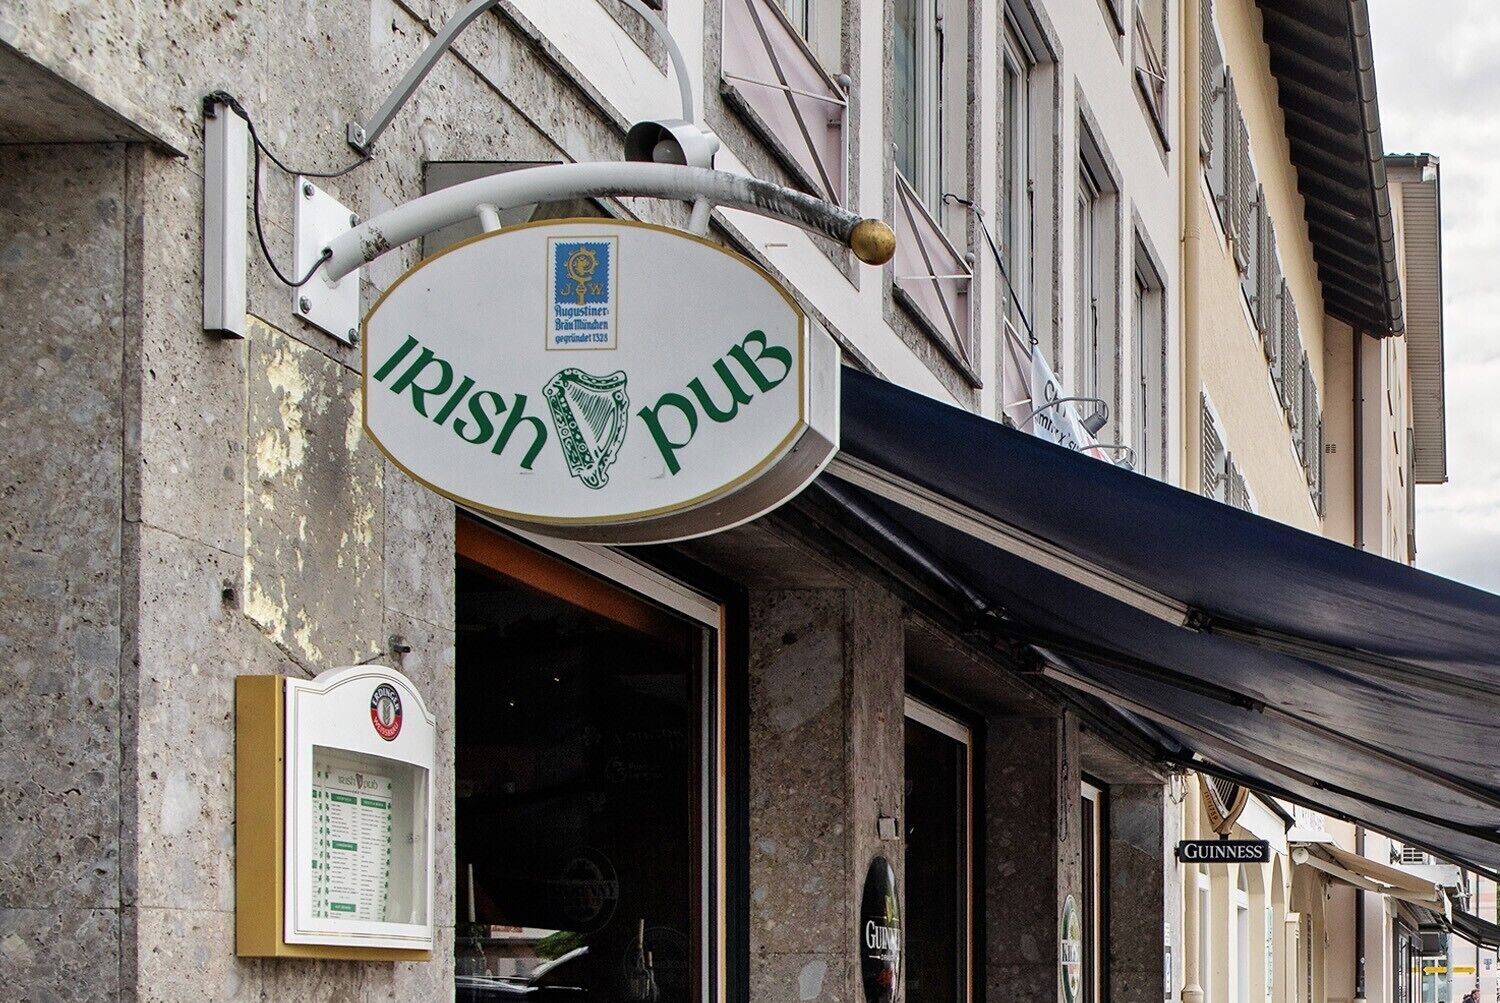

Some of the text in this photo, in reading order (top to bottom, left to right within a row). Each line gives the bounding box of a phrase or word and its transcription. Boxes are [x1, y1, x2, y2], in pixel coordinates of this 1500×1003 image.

[554, 318, 608, 331] Bräu München
[592, 333, 608, 342] 1328
[1184, 843, 1264, 859] GUINNESS
